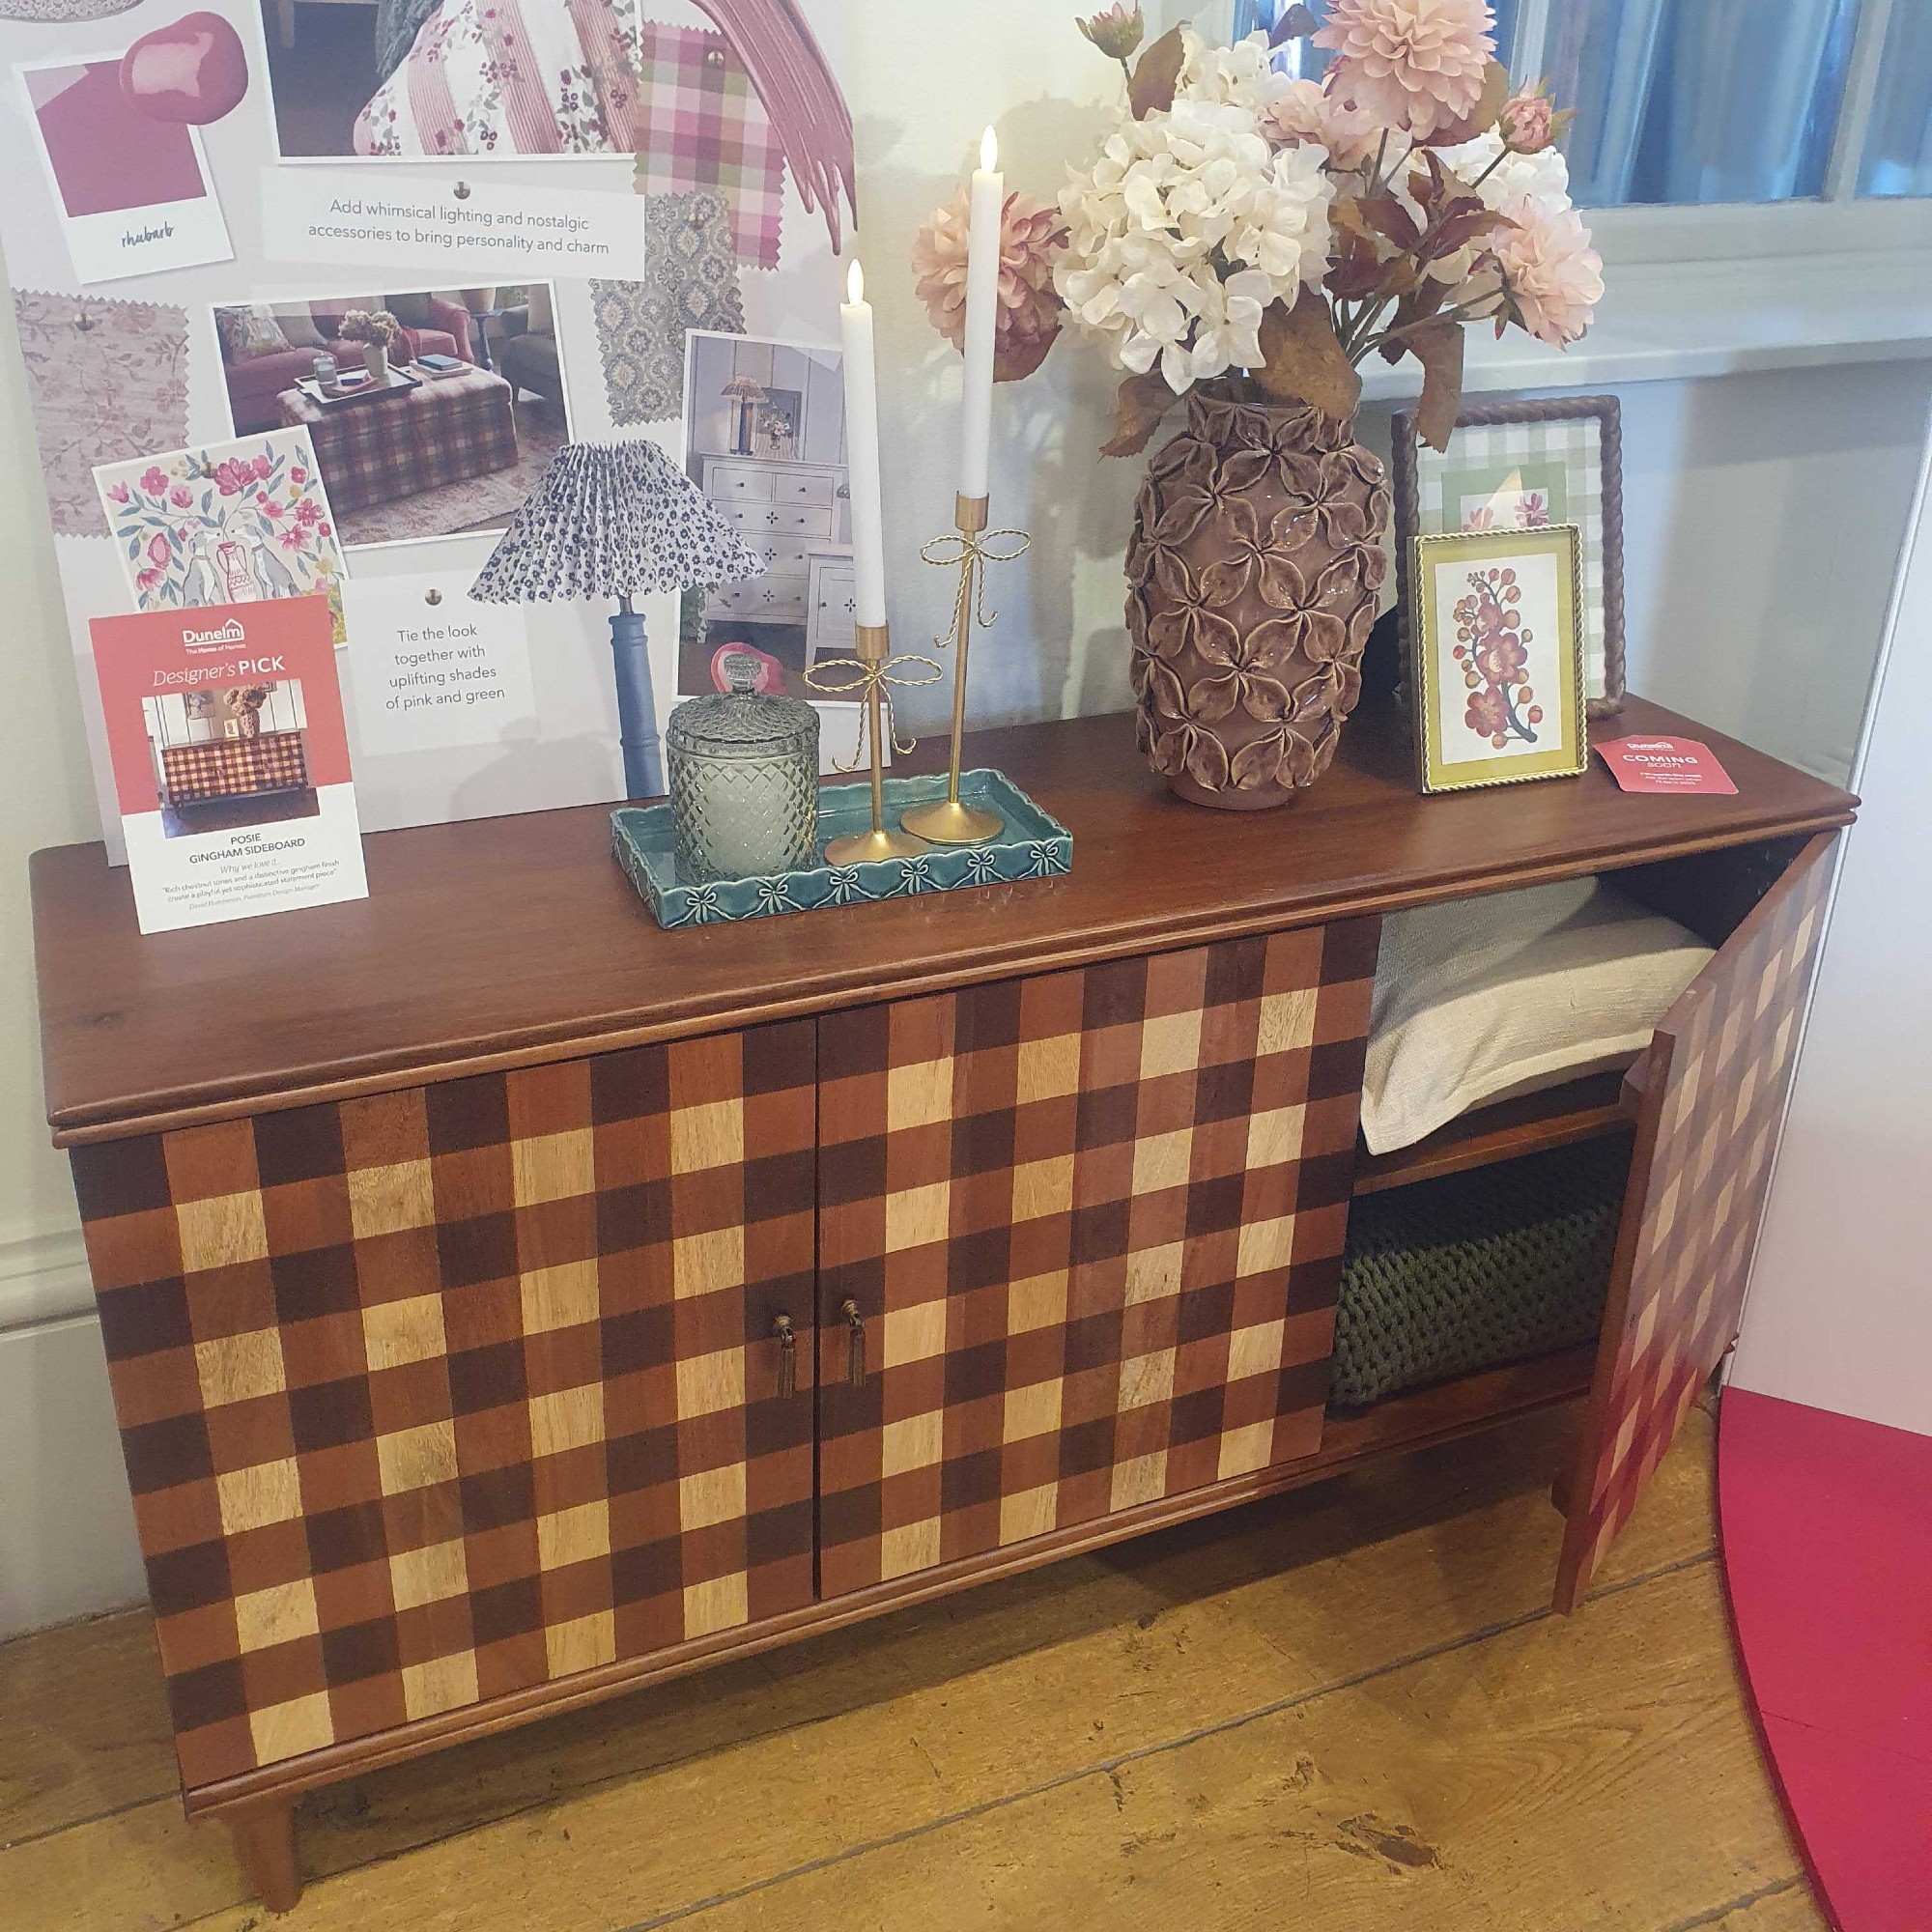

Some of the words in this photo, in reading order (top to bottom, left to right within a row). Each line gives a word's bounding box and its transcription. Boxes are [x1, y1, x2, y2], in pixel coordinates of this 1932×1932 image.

[329, 199, 362, 214] Add
[366, 202, 436, 219] whimsical
[440, 206, 493, 227] lighting
[497, 212, 523, 225] and
[527, 214, 589, 233] nostalgic
[122, 220, 175, 247] rhubarb
[308, 225, 392, 241] accessories
[395, 230, 411, 242] to
[415, 228, 452, 248] bring
[457, 235, 533, 253] personality
[537, 238, 563, 251] and
[567, 239, 610, 254] charm
[183, 624, 242, 644] Dunelm
[397, 630, 419, 642] Tie
[422, 627, 444, 639] the
[447, 623, 478, 638] look
[395, 648, 454, 667] together
[457, 644, 486, 659] with
[153, 663, 236, 687] Designer's
[238, 655, 286, 675] PICK
[389, 672, 445, 690] uplifting
[449, 667, 497, 681] shades
[385, 696, 400, 709] of
[404, 693, 433, 711] pink
[436, 690, 462, 704] and
[466, 689, 505, 704] green
[1623, 754, 1698, 764] COMING
[230, 833, 262, 845] POSIE
[189, 847, 242, 864] GINGHAM
[244, 838, 305, 856] SIDEBOARD
[220, 865, 240, 874] Why
[254, 859, 270, 868] love
[290, 863, 321, 874] gingham
